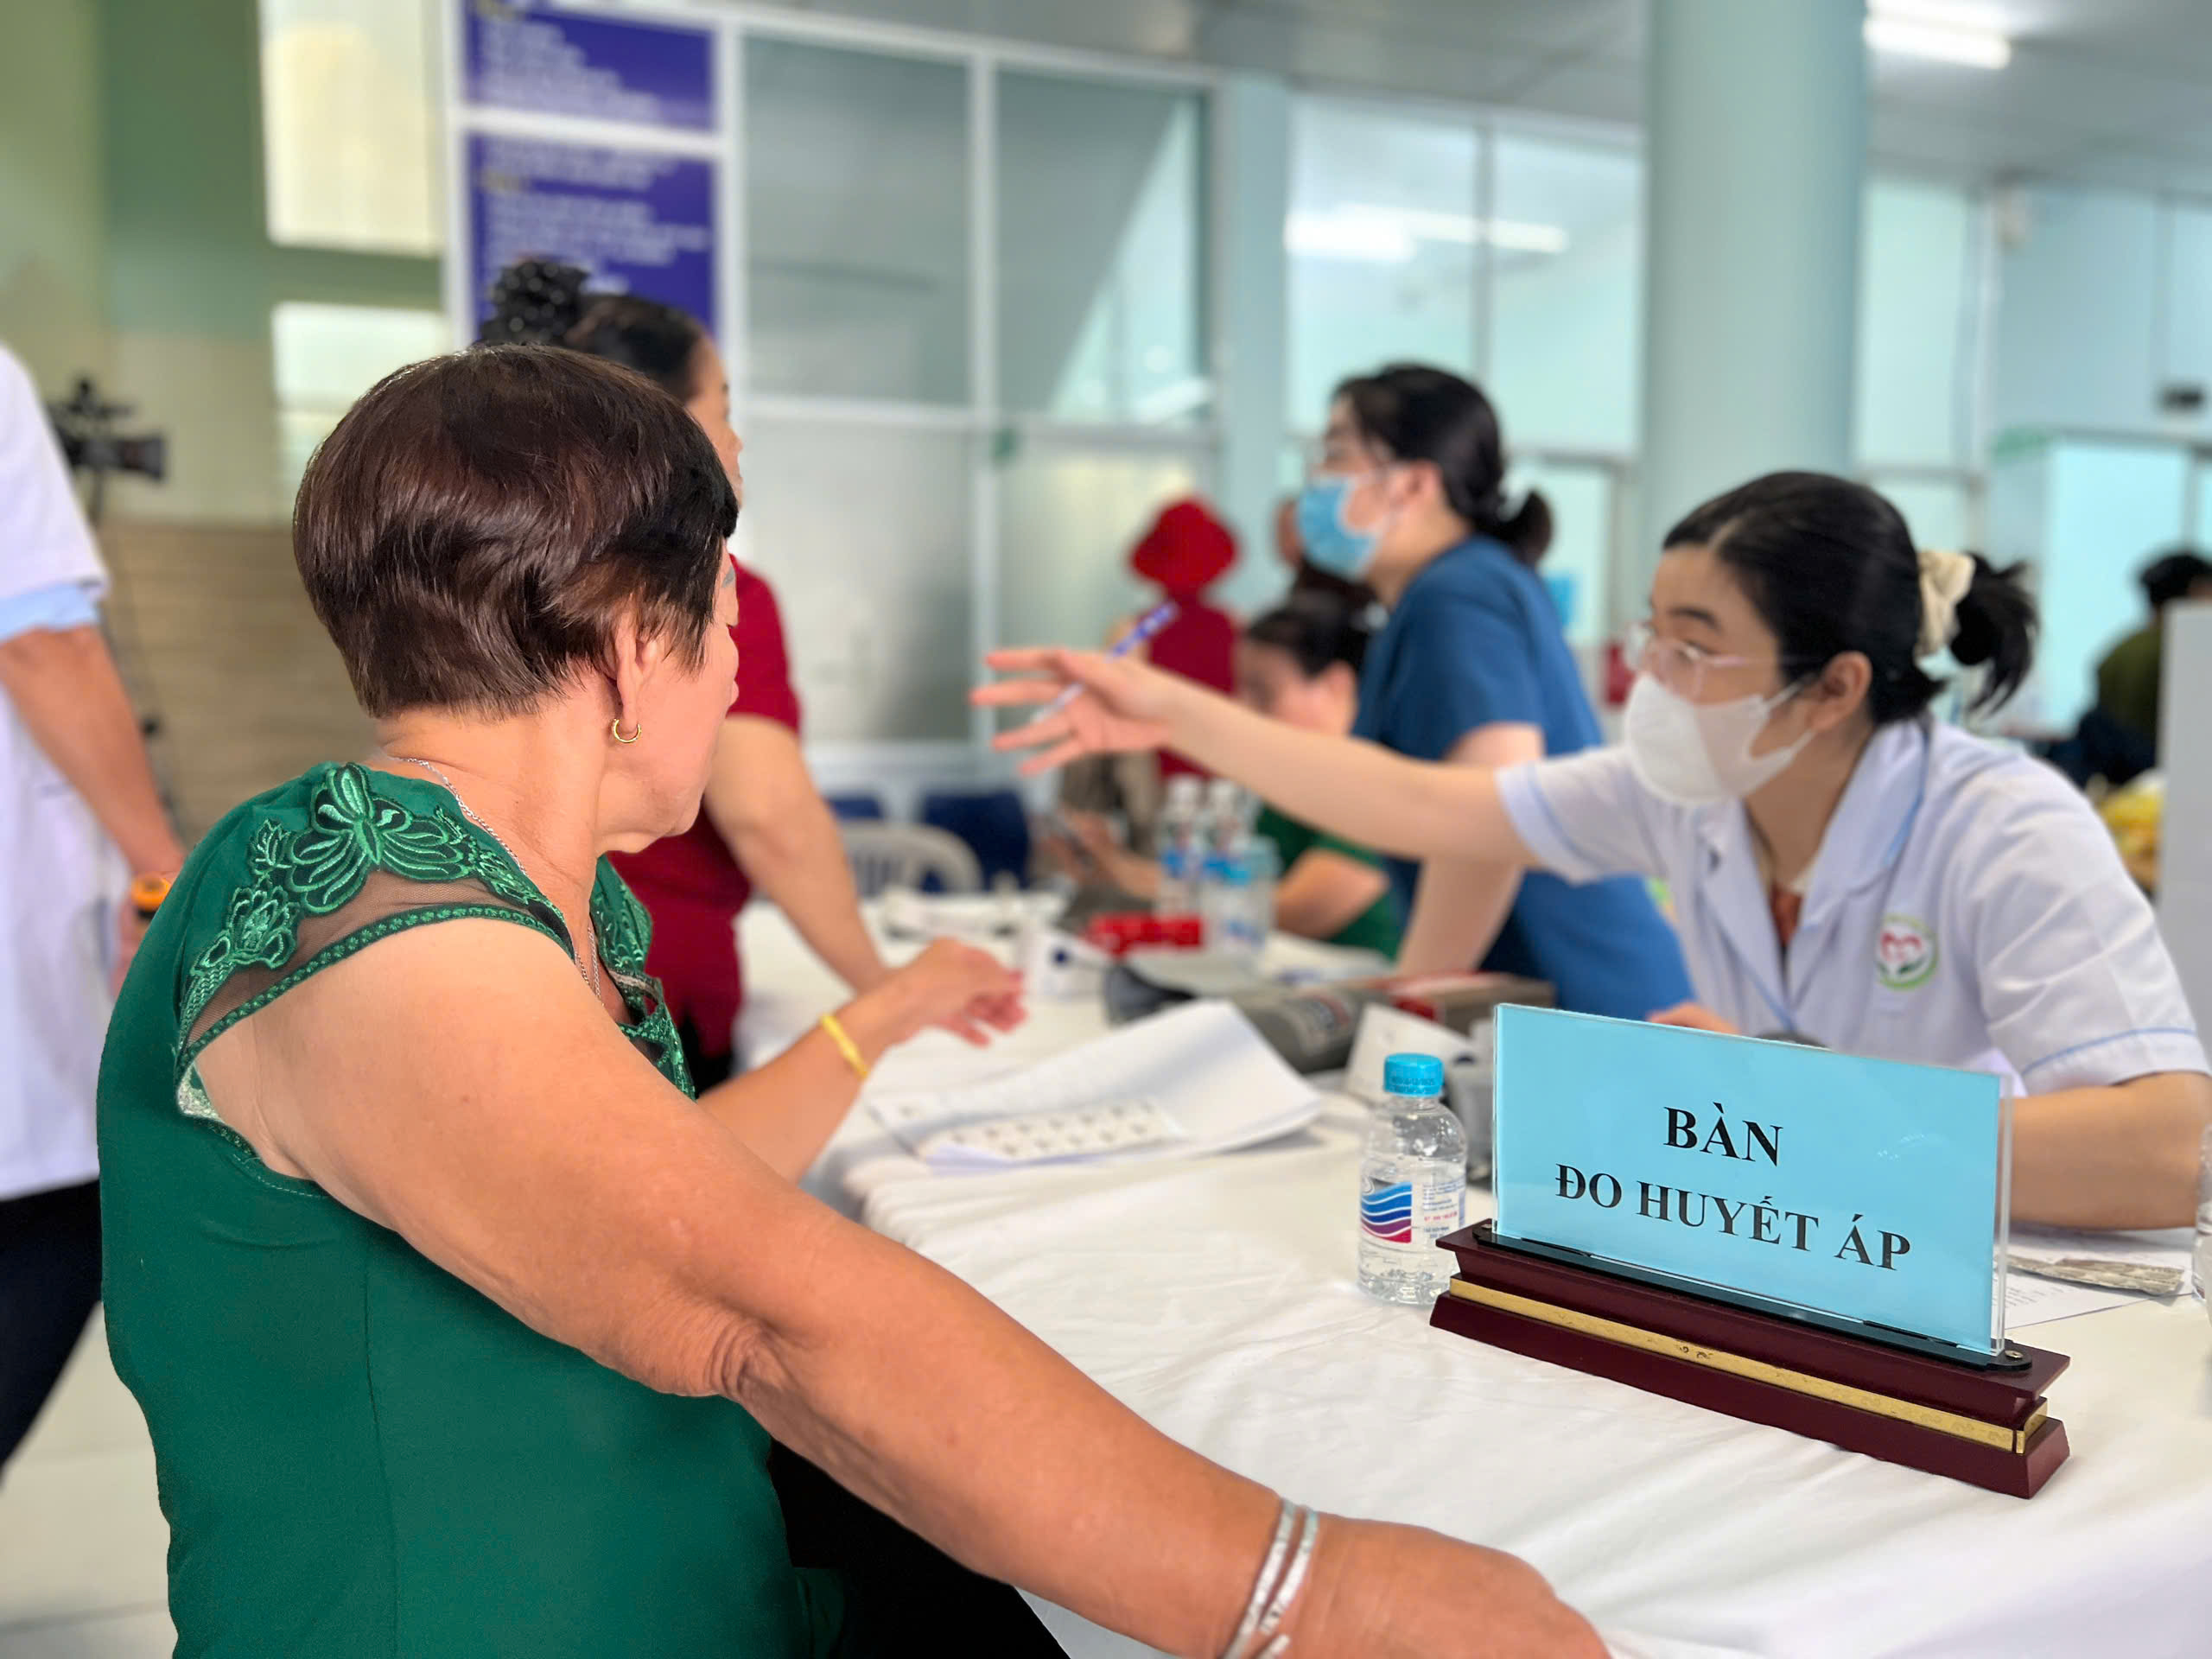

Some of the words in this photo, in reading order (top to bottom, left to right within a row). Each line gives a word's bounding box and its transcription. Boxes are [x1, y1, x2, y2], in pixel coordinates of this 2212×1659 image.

[1662, 1102, 1783, 1167] BÀN
[1554, 1163, 1622, 1209] ĐO
[1636, 1180, 1819, 1252] HUYẾT
[1834, 1213, 1910, 1271] ÁP
